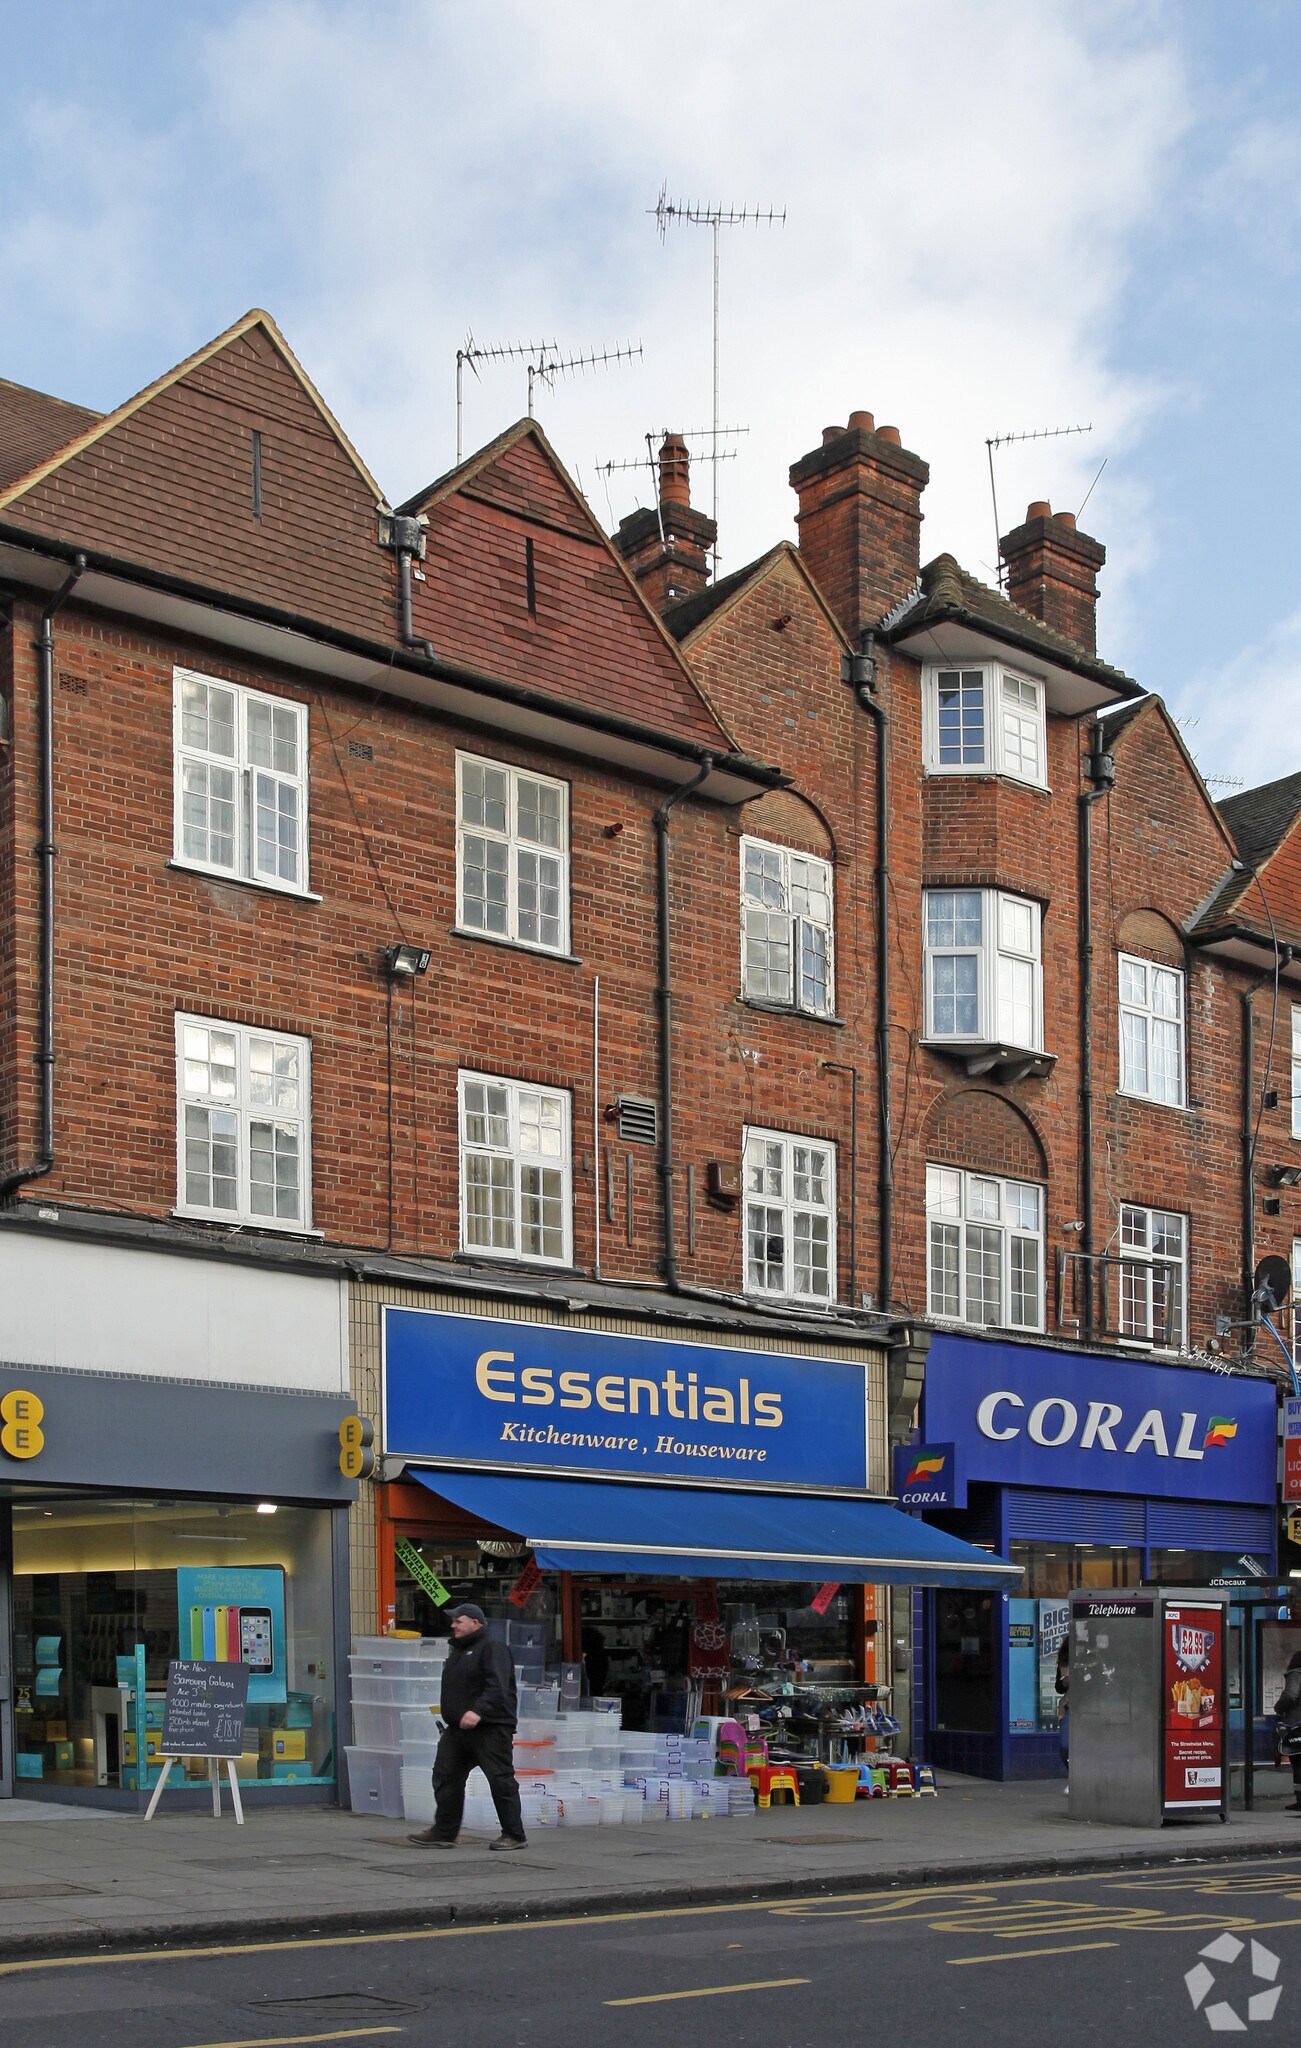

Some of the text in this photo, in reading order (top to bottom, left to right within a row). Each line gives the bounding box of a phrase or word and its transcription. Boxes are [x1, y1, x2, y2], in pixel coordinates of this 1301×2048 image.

[474, 1350, 784, 1428] Essentials
[976, 1390, 1205, 1460] CORAL
[500, 1421, 639, 1451] Kitchenware
[654, 1435, 768, 1463] Houseware
[902, 1491, 947, 1504] CORAL
[395, 1542, 440, 1600] MANAGEMENT
[402, 1543, 441, 1590] UNDER NEW
[1209, 1579, 1246, 1587] JCDecaux
[1089, 1604, 1137, 1617] Telephone
[1182, 1629, 1203, 1655] £2.99
[171, 1661, 190, 1672] The
[17, 1687, 30, 1700] 25
[192, 1688, 199, 1697] 3
[170, 1698, 190, 1708] 1000
